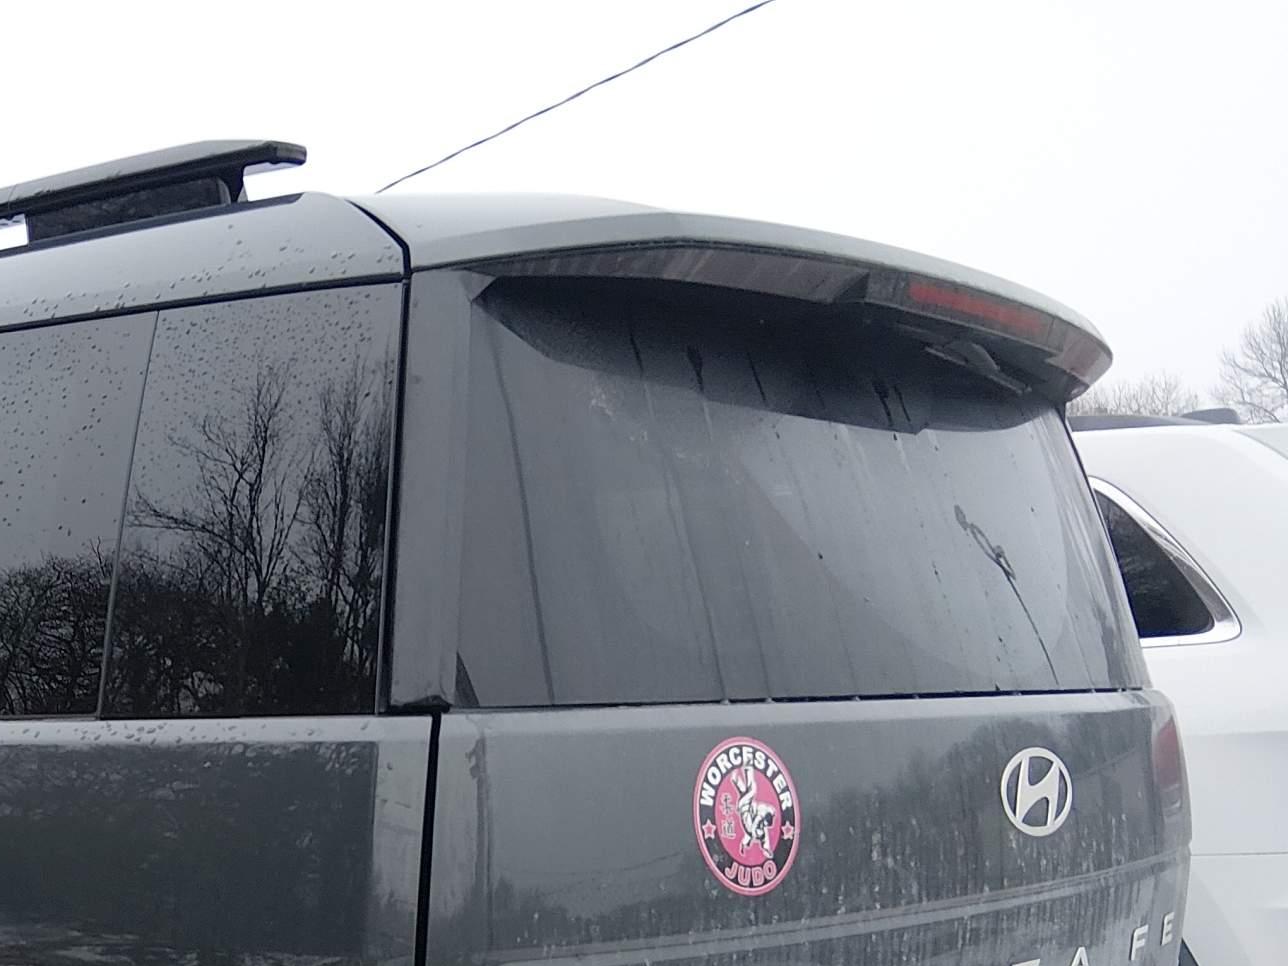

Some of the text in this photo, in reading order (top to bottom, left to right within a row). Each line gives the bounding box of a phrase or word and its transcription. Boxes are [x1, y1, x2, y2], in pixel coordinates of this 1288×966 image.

[700, 746, 793, 811] WORCESTER
[725, 860, 777, 887] JUDO
[1130, 911, 1176, 961] FE
